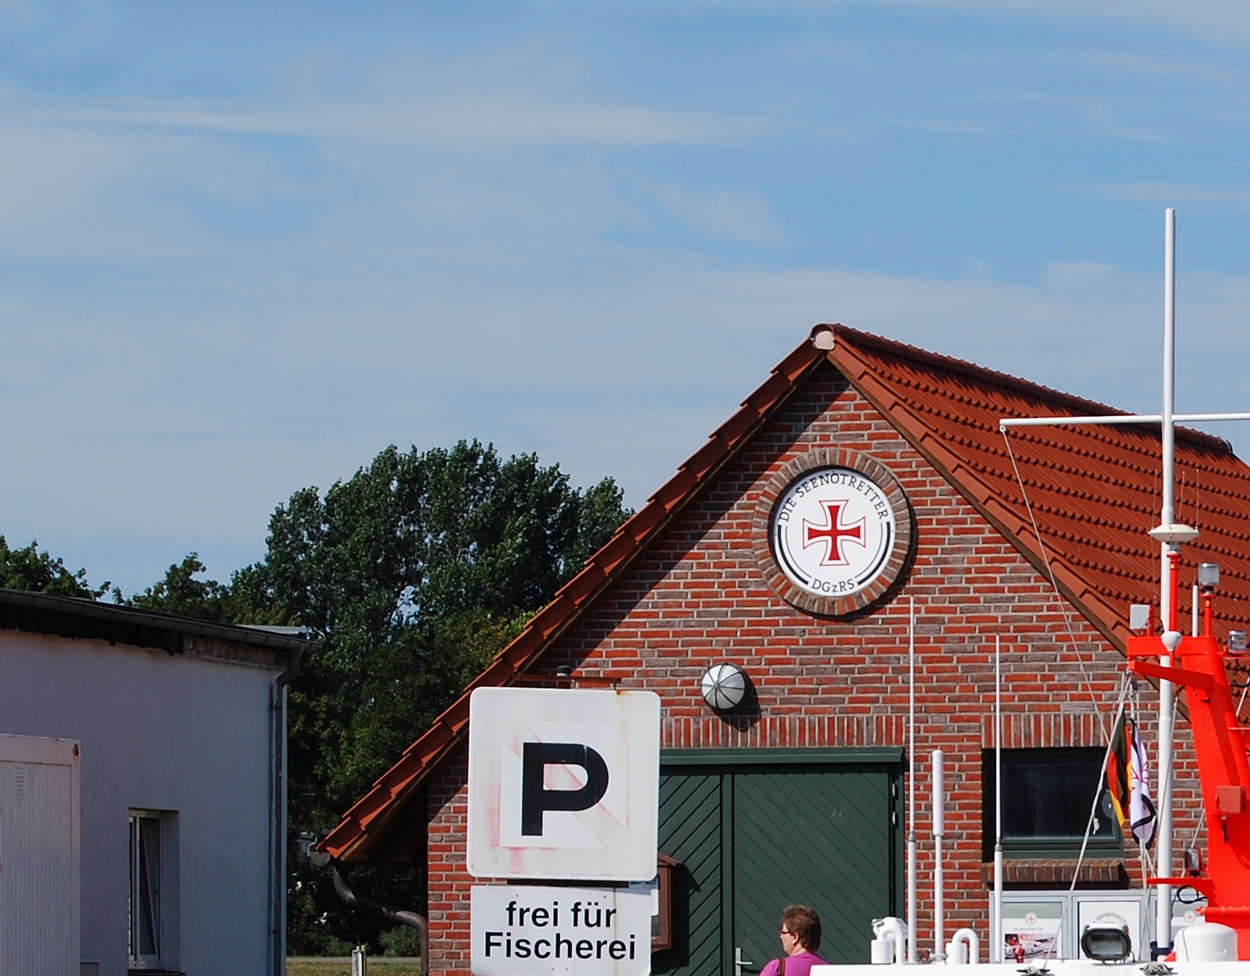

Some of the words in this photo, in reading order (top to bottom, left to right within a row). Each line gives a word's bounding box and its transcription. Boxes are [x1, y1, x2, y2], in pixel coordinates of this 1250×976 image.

[778, 497, 797, 523] DIE
[795, 472, 889, 519] SEENOTRETTER
[811, 578, 856, 593] DGzRS
[521, 742, 610, 837] P
[505, 901, 559, 927] frei
[570, 901, 617, 928] für
[484, 931, 636, 960] Fischerei
